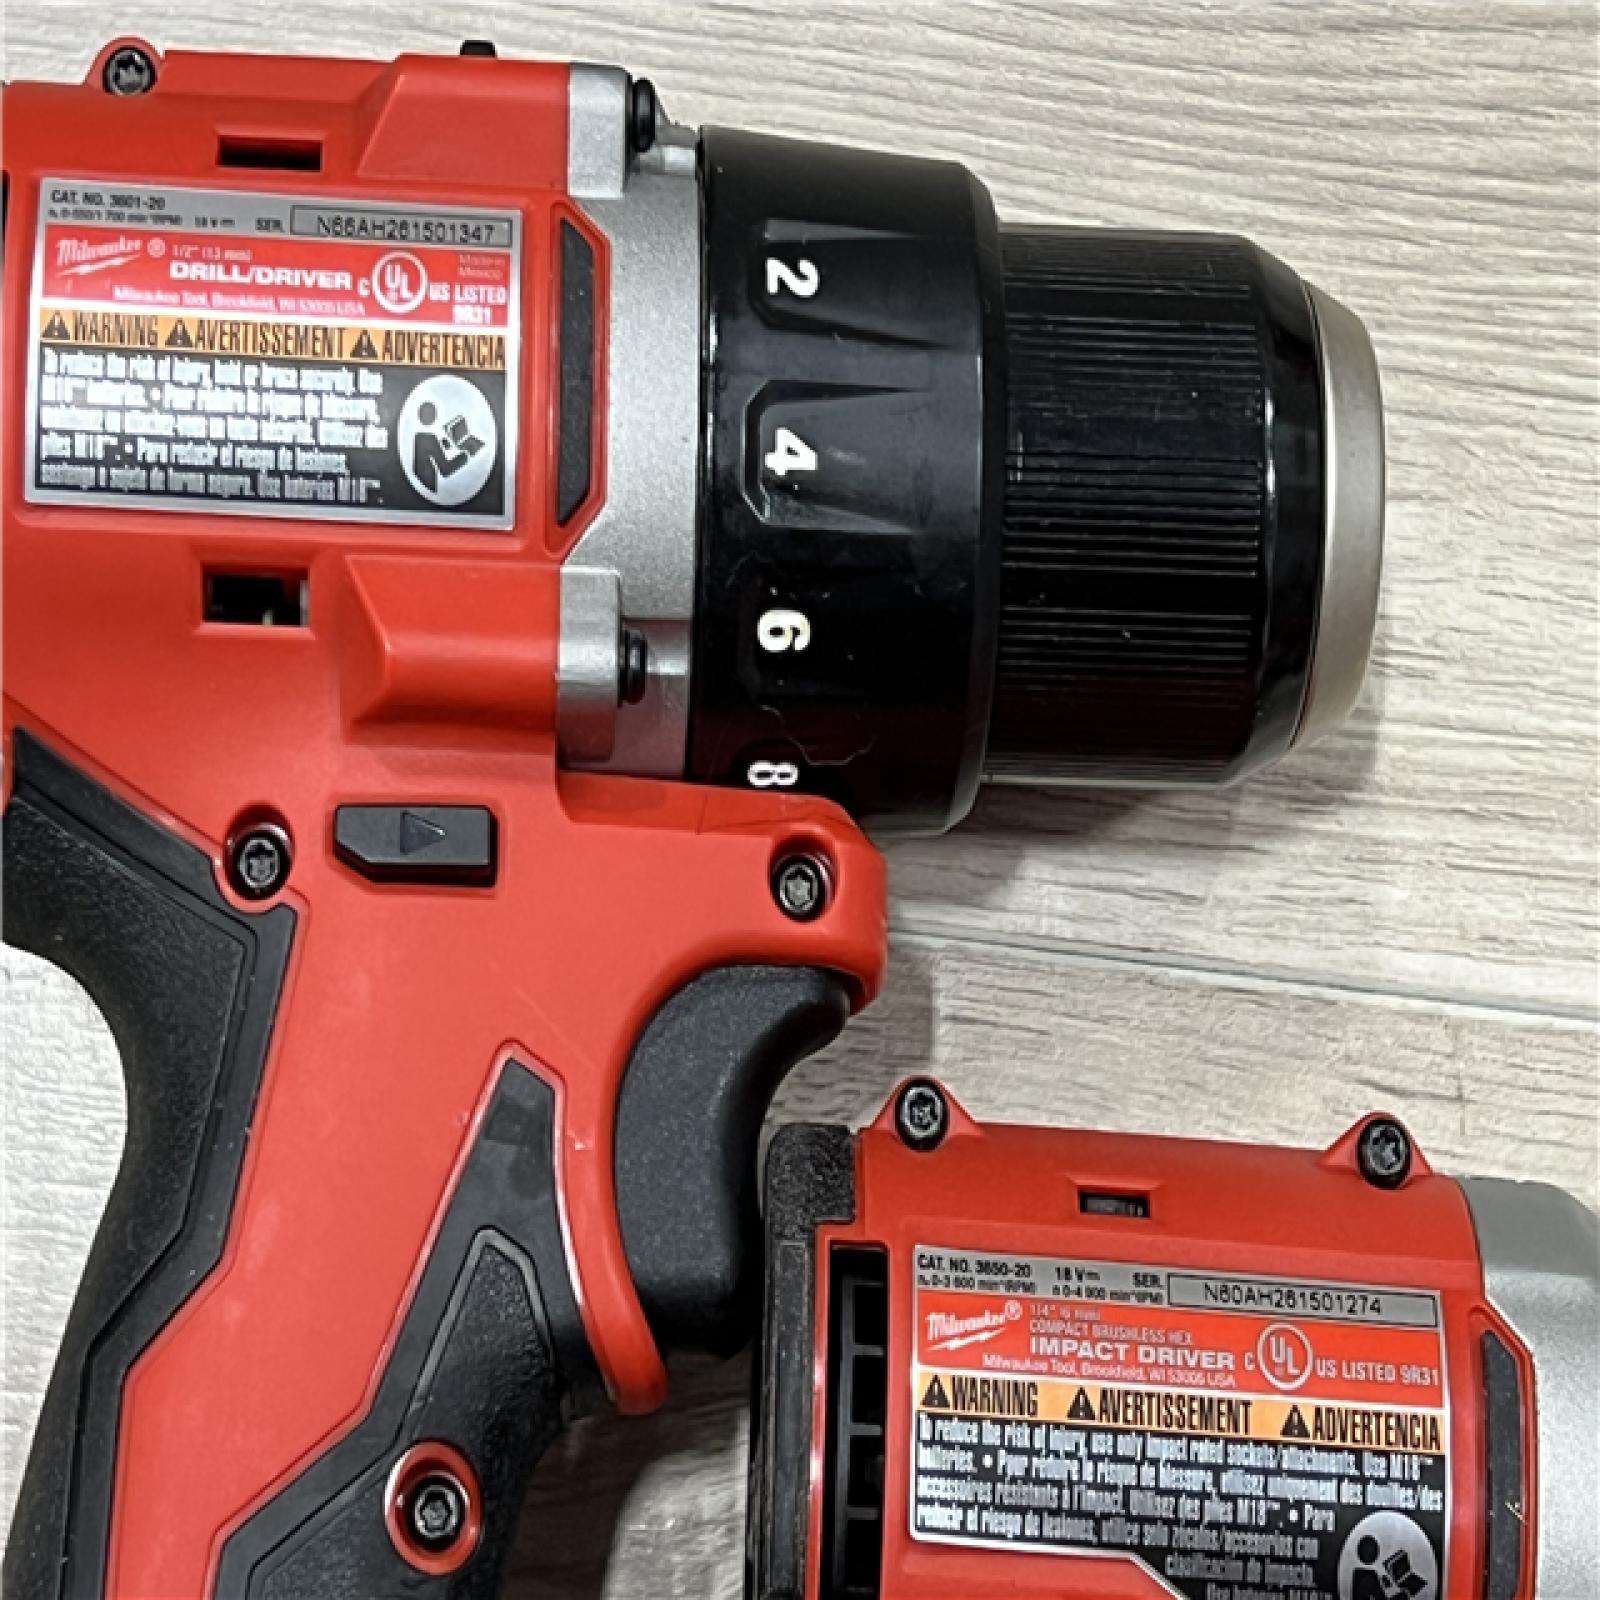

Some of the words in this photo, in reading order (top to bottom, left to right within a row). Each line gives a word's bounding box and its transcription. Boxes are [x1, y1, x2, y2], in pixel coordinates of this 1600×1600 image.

[50, 190, 78, 204] CAT.
[82, 191, 104, 206] NO.
[56, 235, 143, 266] Milwaukee
[169, 261, 351, 289] DRILL/DRIVER
[766, 258, 819, 297] 2
[454, 285, 506, 304] LISTED
[73, 312, 159, 346] WARNING
[196, 319, 346, 358] AVERTISSEMENT
[383, 329, 504, 368] ADVERTENCIA
[765, 426, 817, 476] 4
[757, 609, 810, 654] 6
[748, 760, 798, 788] 8
[917, 1254, 944, 1271] CAT.
[950, 1258, 972, 1274] NO.
[975, 1260, 1031, 1277] 3650-20
[1055, 1267, 1072, 1282] 18
[1132, 1272, 1165, 1290] SER.
[925, 1309, 1006, 1341] Milwaukee
[1030, 1319, 1088, 1337] COMPACT
[1092, 1324, 1166, 1343] BRUSHLESS
[1030, 1336, 1130, 1361] IMPACT
[1138, 1344, 1235, 1370] DRIVER
[983, 1354, 1049, 1374] Milwaukee
[1050, 1359, 1077, 1376] Tool,
[1081, 1361, 1147, 1381] Brookfield,
[1207, 1371, 1235, 1389] USA
[1315, 1359, 1336, 1377] US
[1342, 1361, 1396, 1382] LISTED
[952, 1375, 1038, 1417] WARNING
[1100, 1387, 1252, 1435] AVERTISSEMENT
[1313, 1406, 1441, 1451] ADVERTENCIA
